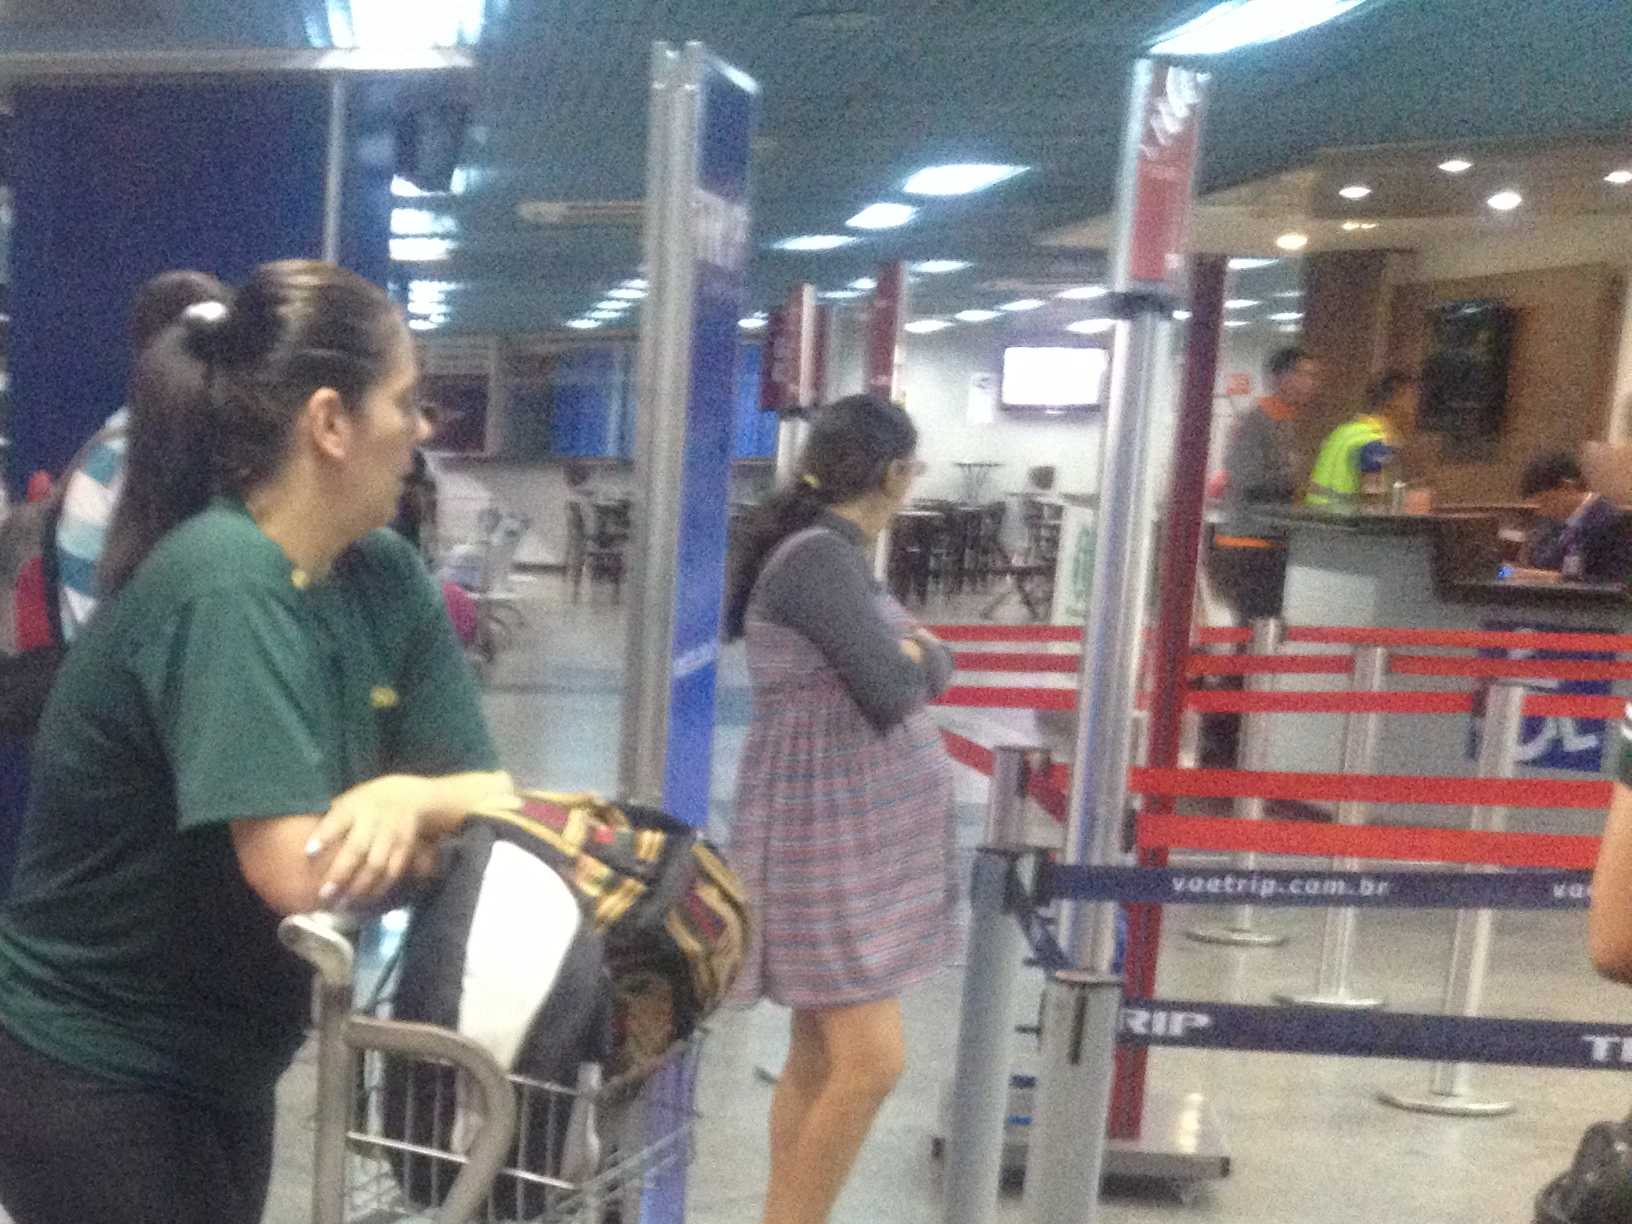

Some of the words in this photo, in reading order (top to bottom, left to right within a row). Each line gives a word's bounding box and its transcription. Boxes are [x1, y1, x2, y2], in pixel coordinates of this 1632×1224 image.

[1171, 873, 1390, 898] voetrip.com.br
[1552, 881, 1593, 899] vo
[1120, 1007, 1212, 1037] RIP
